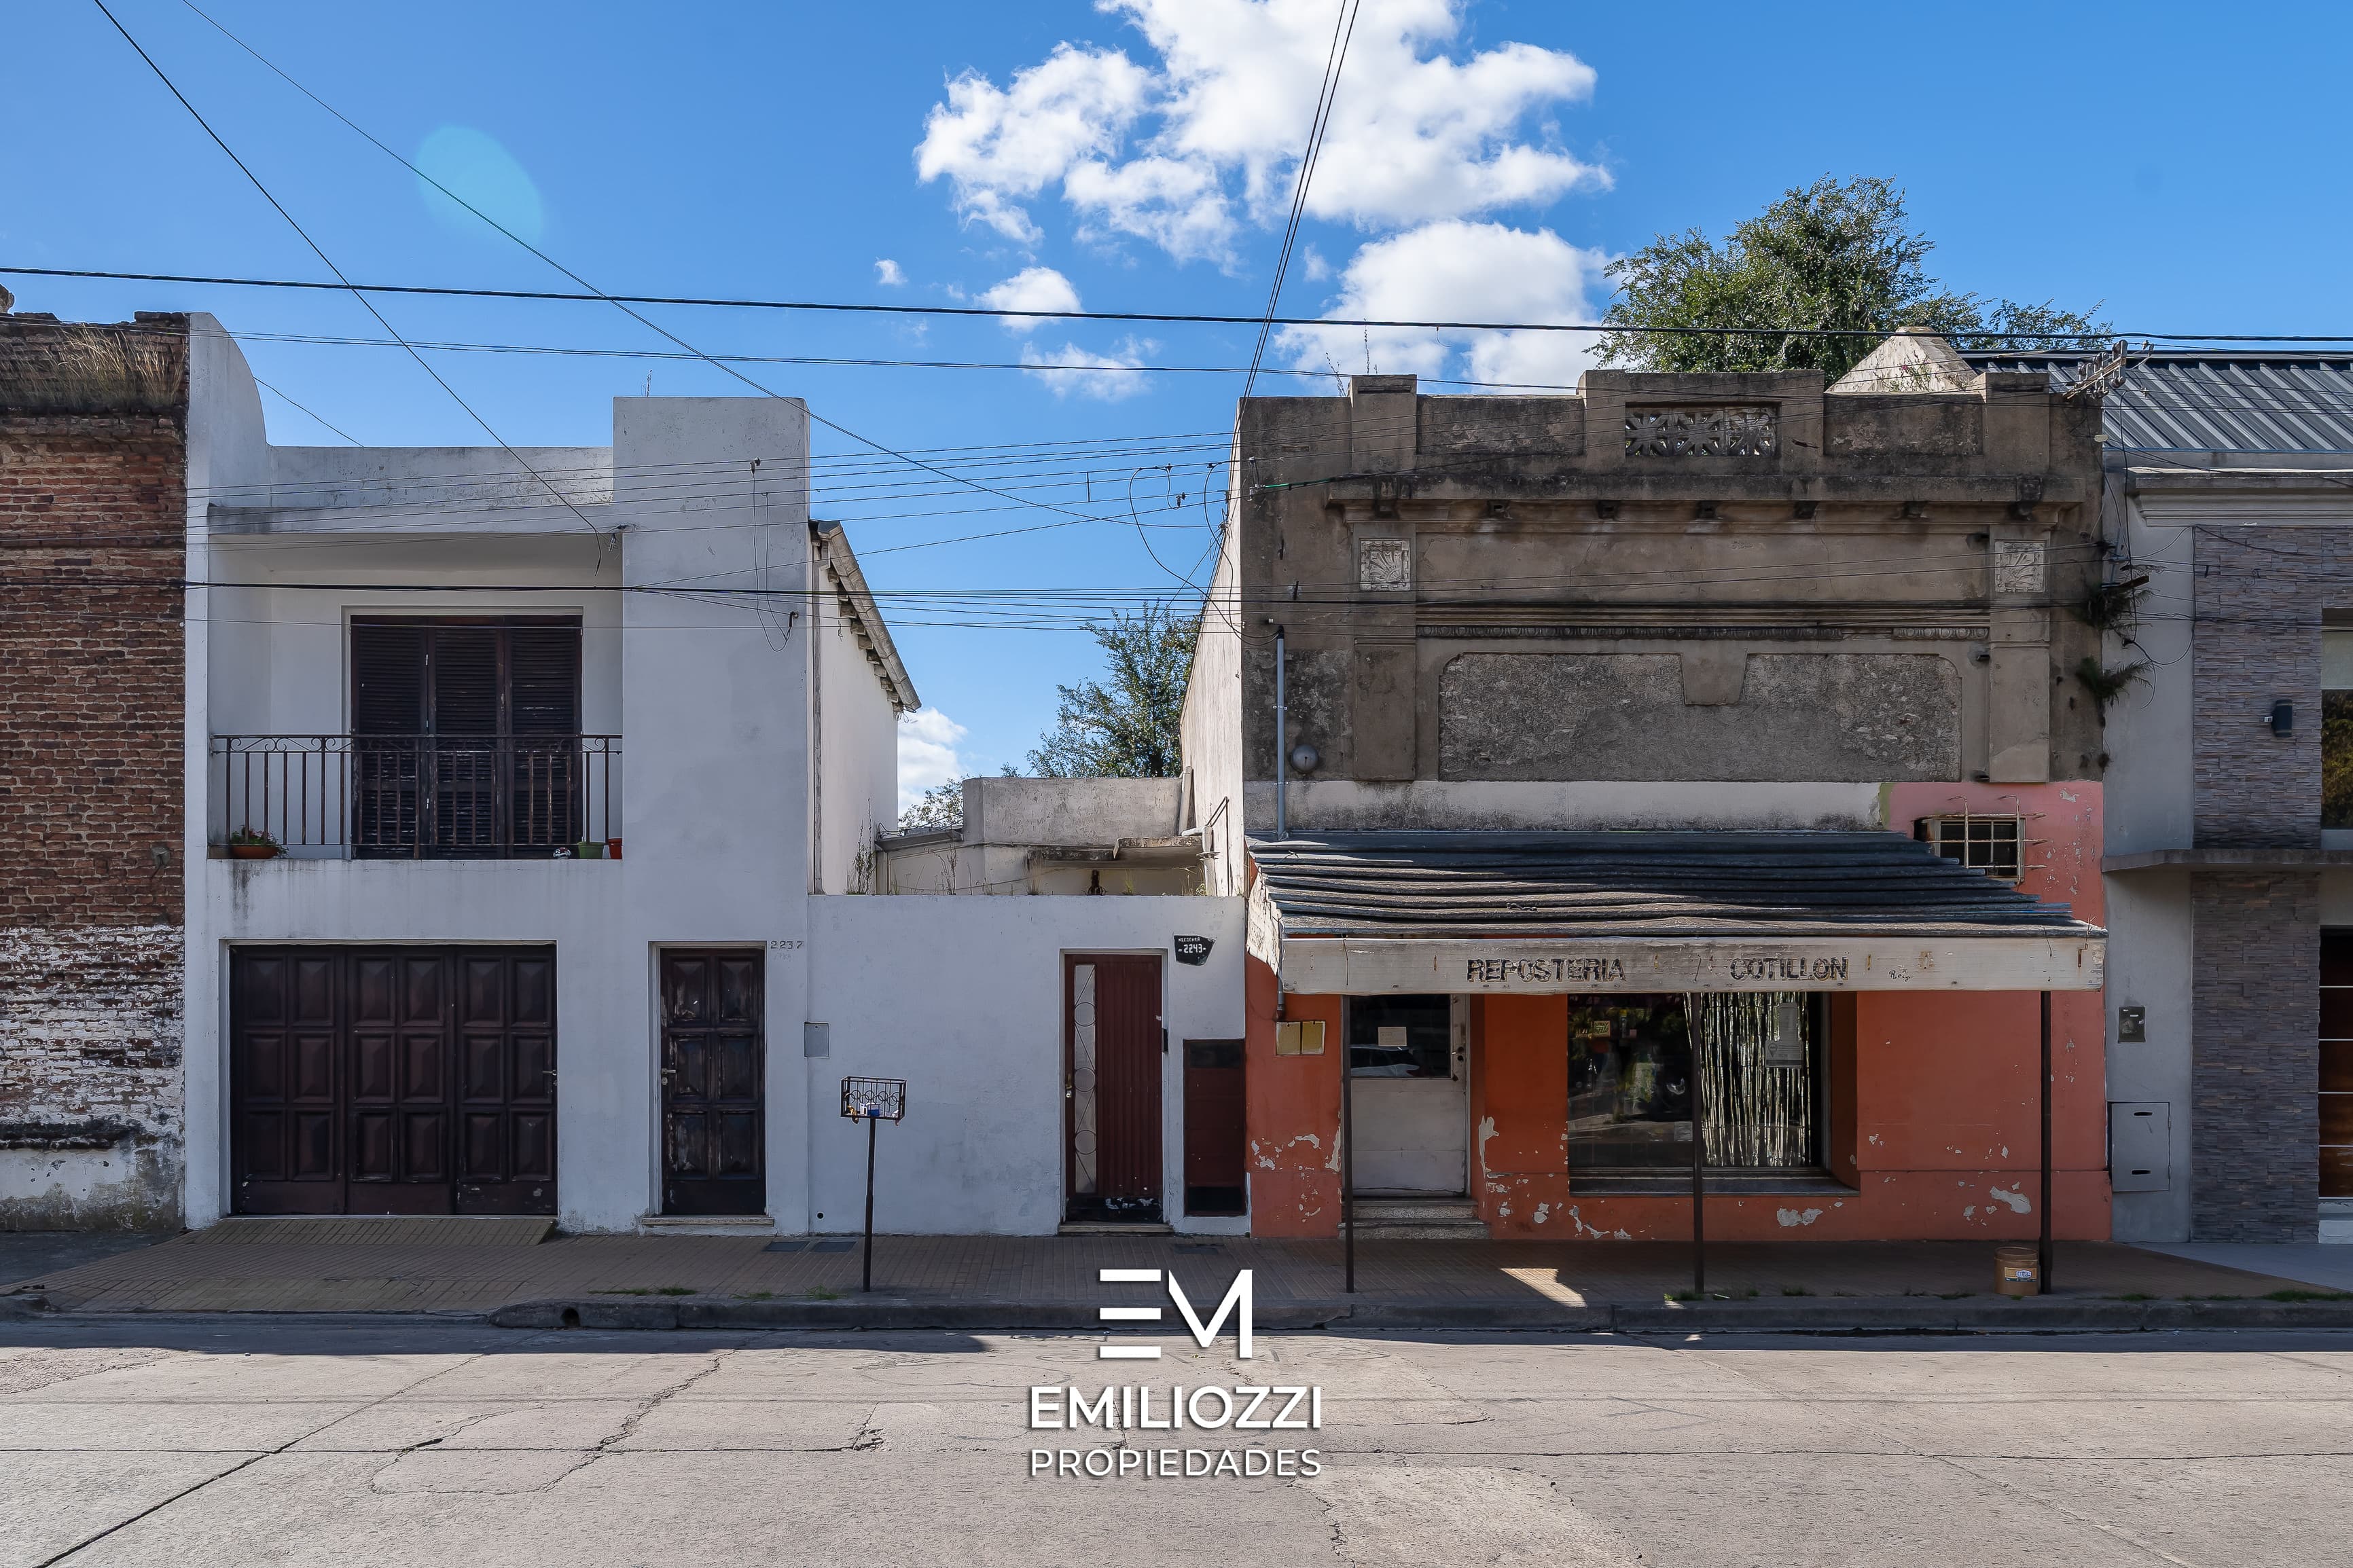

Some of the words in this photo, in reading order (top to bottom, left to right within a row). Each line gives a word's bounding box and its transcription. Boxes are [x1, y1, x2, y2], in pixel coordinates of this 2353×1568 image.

[770, 941, 804, 949] 2237
[1467, 958, 1625, 983] REPOSTERIA
[1730, 957, 1848, 981] COTILLON
